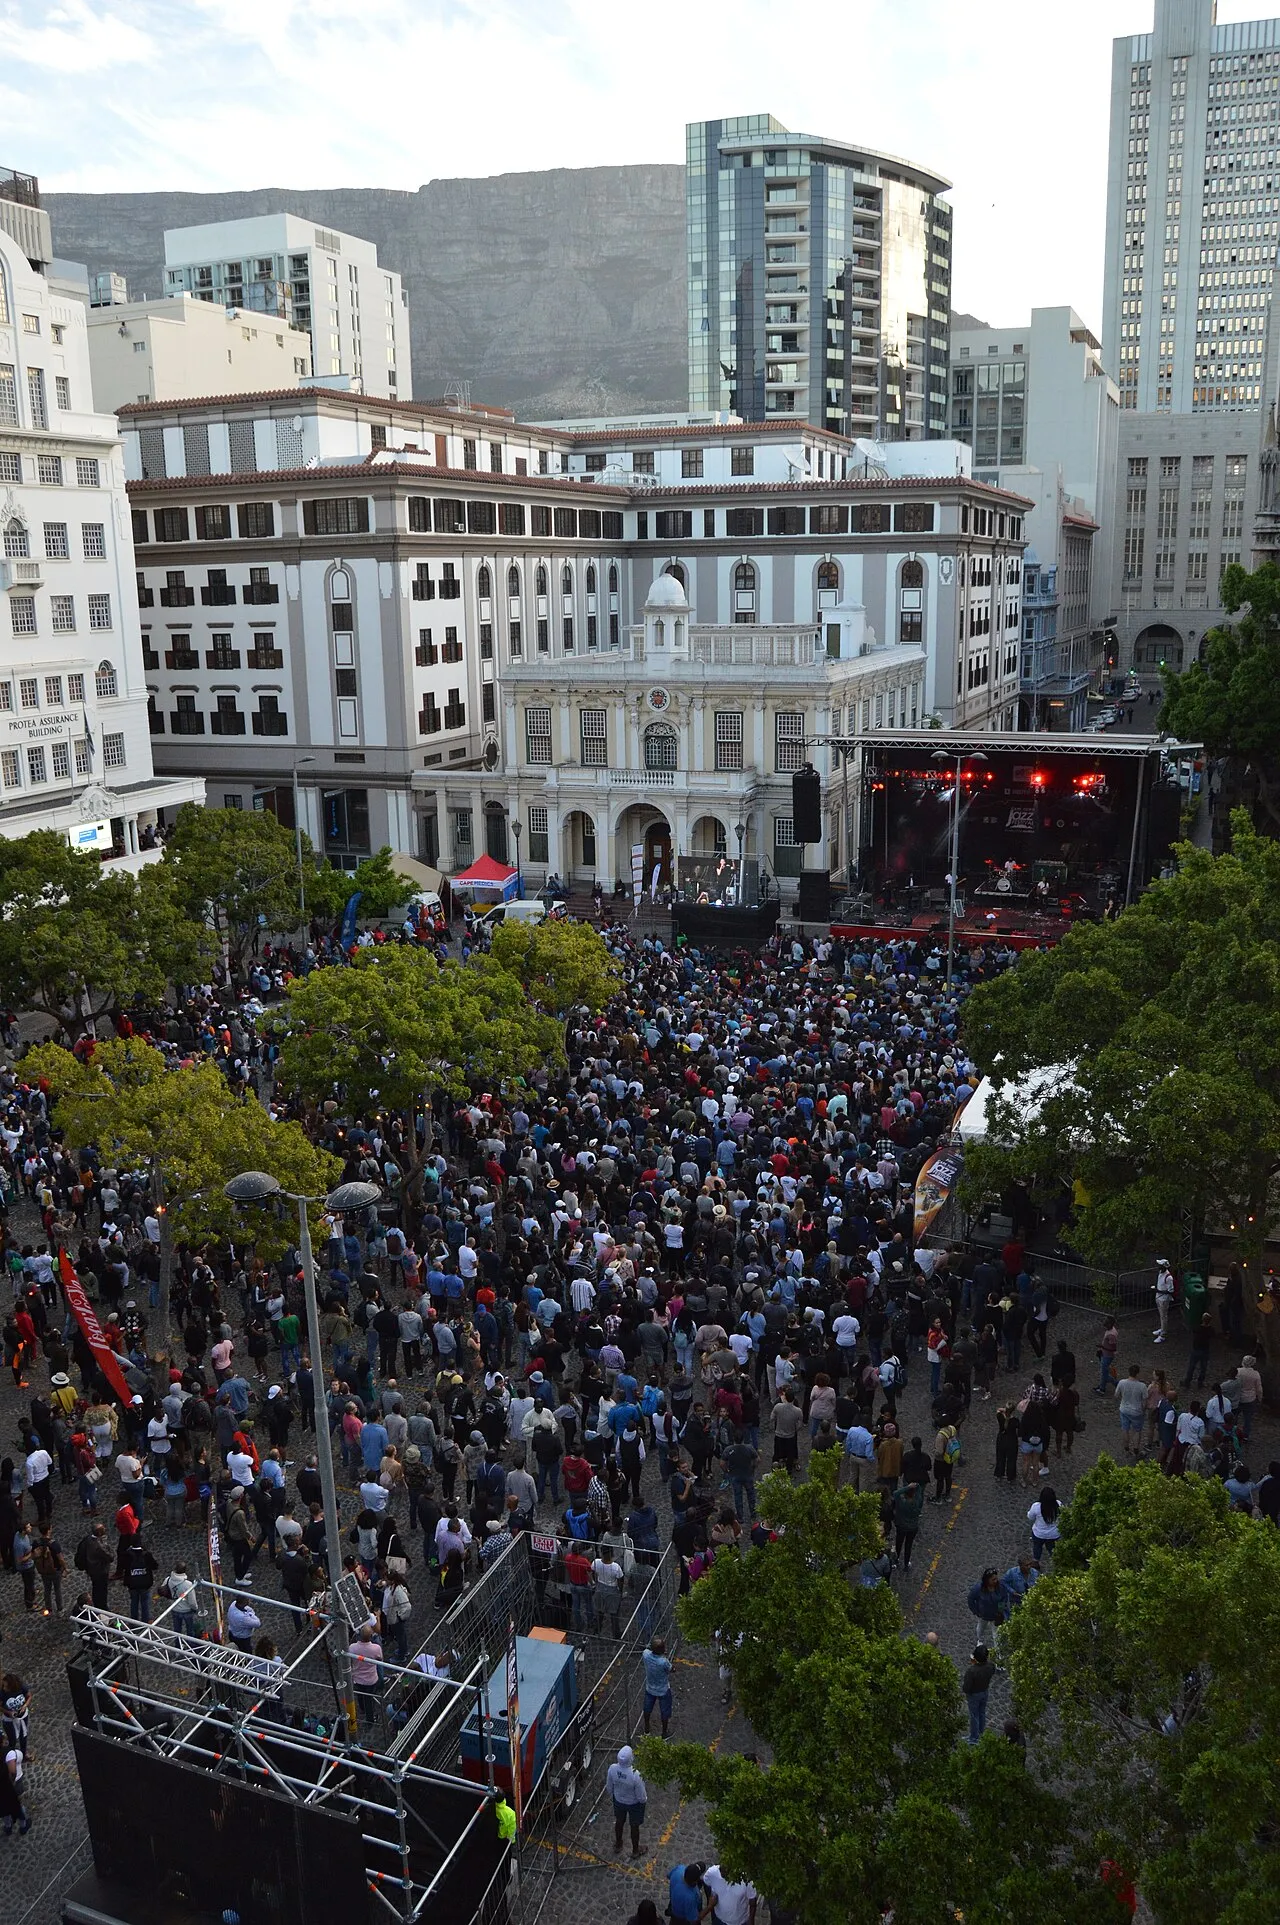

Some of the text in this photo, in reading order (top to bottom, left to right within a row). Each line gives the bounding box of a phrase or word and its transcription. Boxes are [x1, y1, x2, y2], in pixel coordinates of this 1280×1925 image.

[8, 713, 79, 731] PROTEA ASSURANCE
[28, 725, 63, 738] BUILDING
[64, 1279, 111, 1350] Coca-Cola
[534, 1536, 553, 1546] EXIT
[534, 1543, 554, 1552] ONLY
